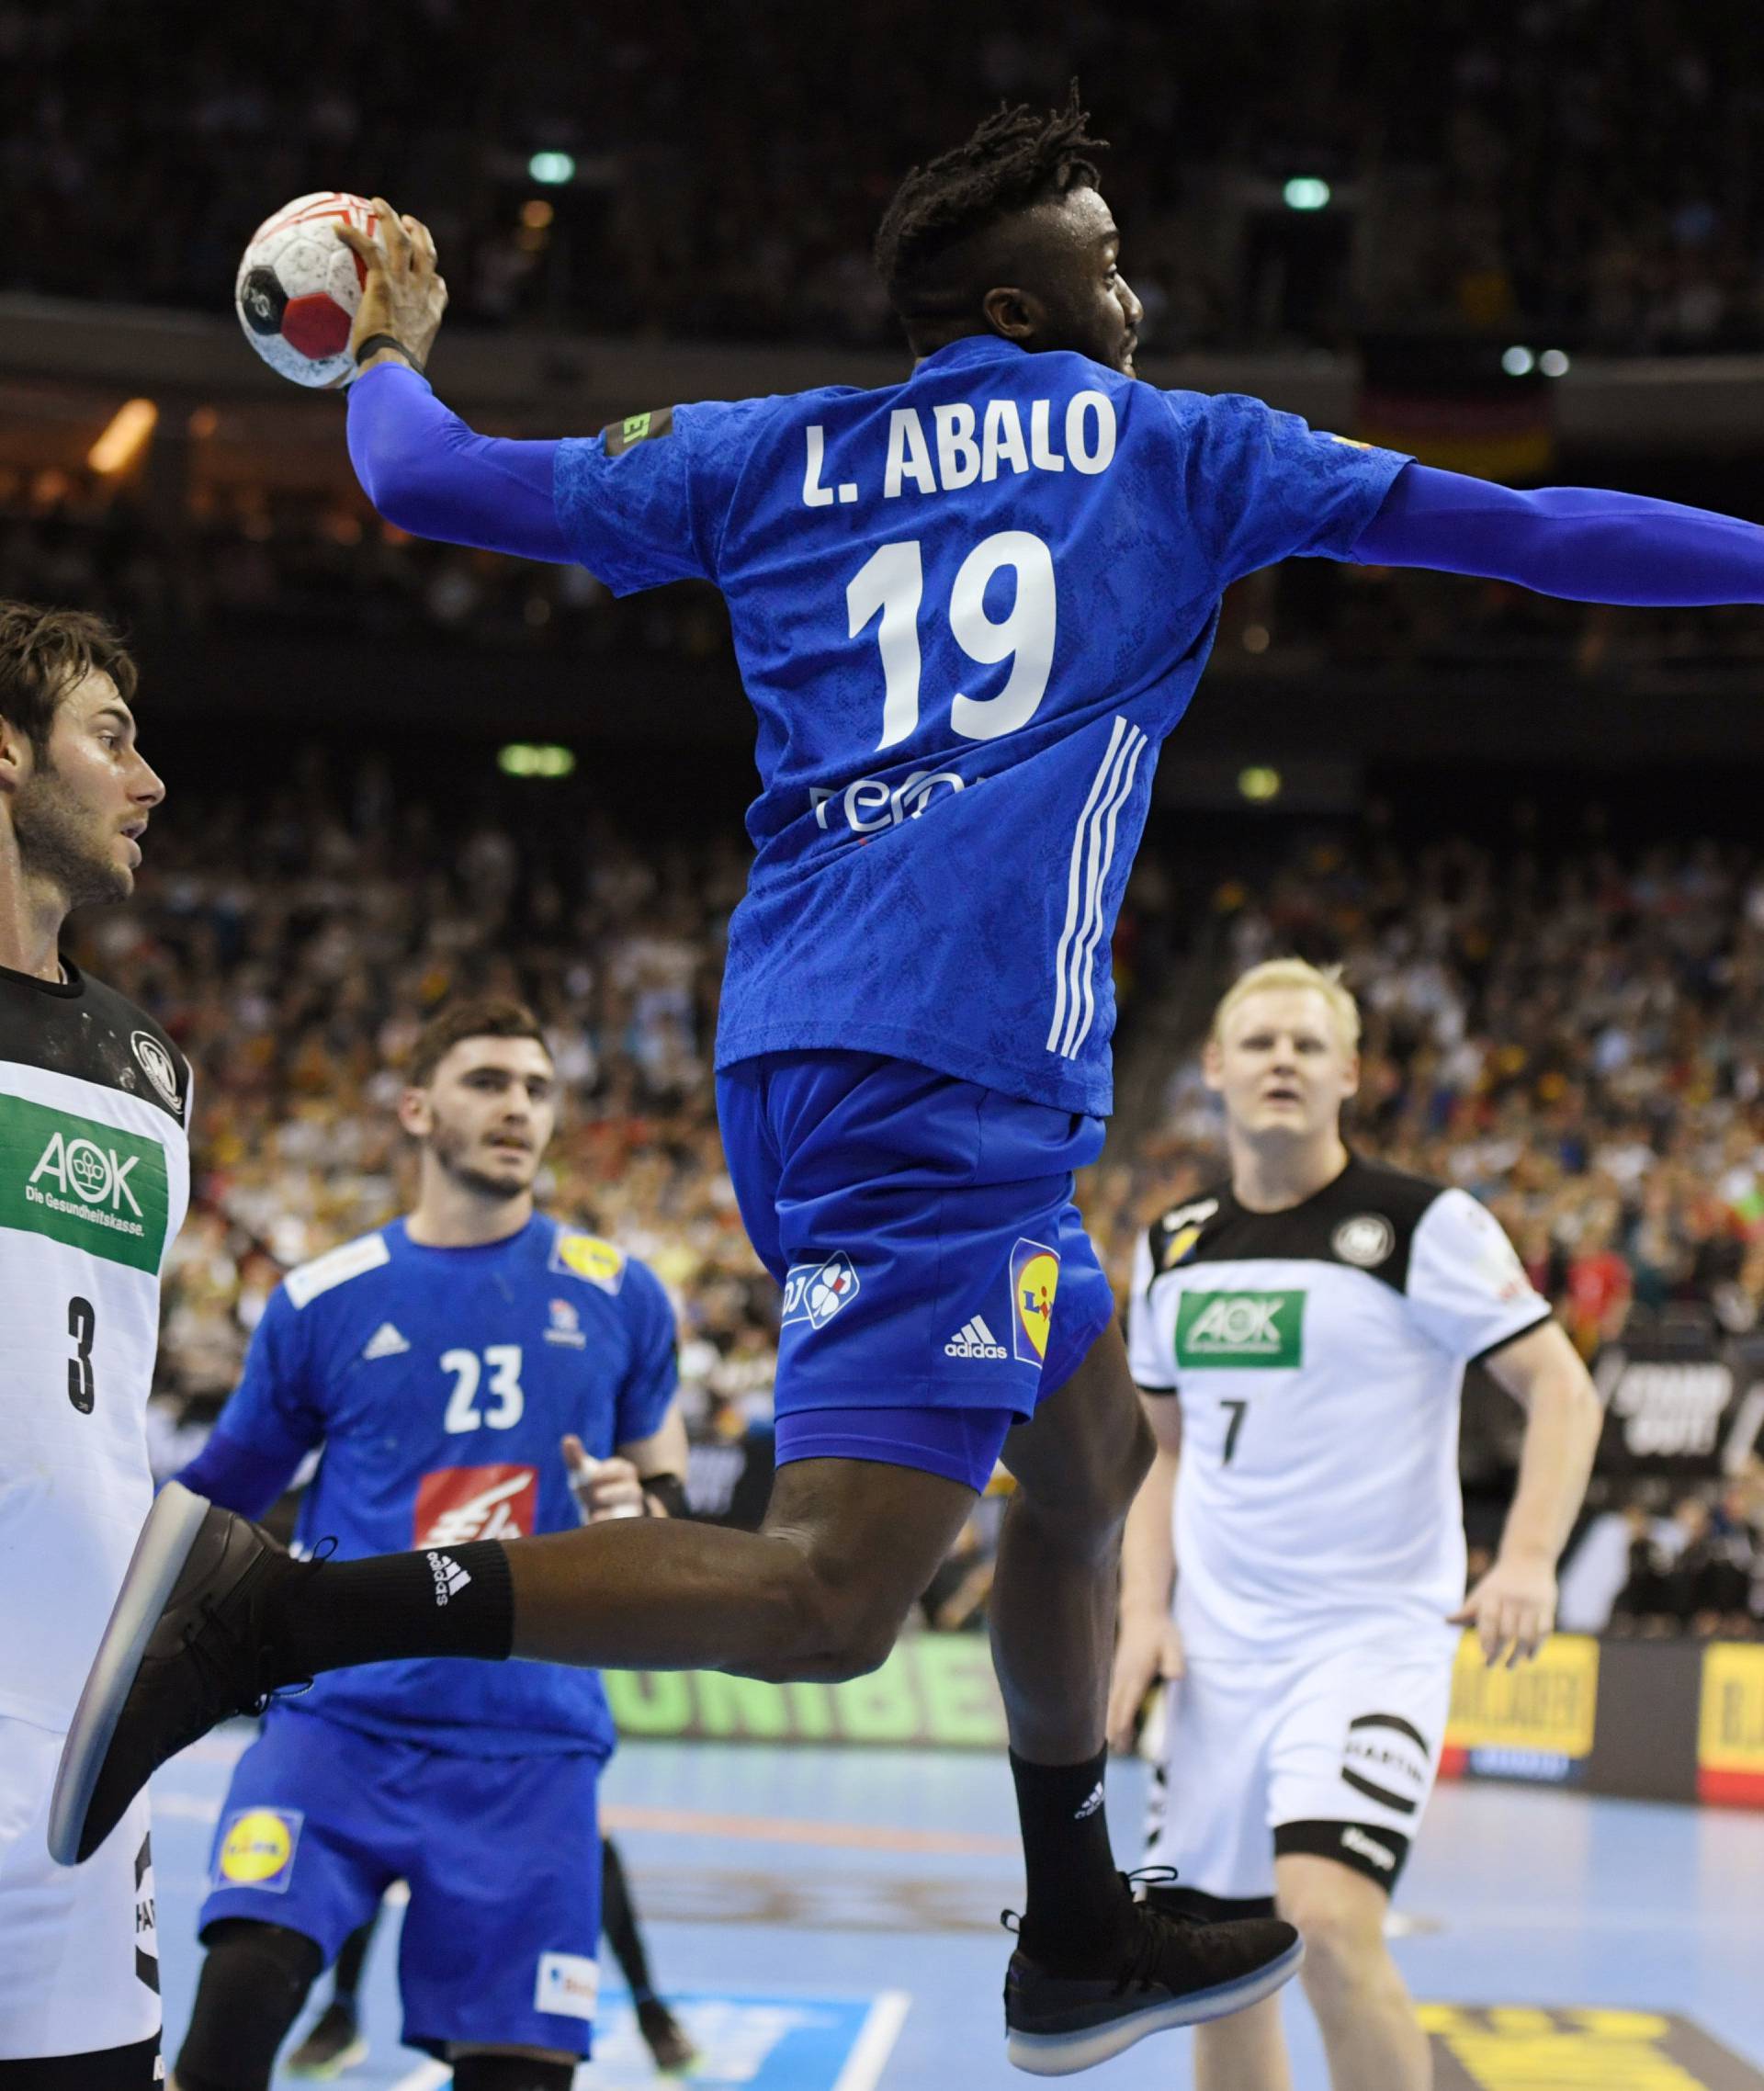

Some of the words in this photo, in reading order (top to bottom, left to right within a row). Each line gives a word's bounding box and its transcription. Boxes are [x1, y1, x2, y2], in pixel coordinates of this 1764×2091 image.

[802, 424, 859, 507] L.
[884, 390, 1117, 498] ABALO
[845, 530, 1057, 751] 19
[808, 771, 987, 832] rem
[28, 1131, 143, 1217] AOK
[25, 1184, 44, 1204] Die
[45, 1192, 145, 1237] Gesundheitskasse.
[944, 1341, 1008, 1360] adidas
[1185, 1297, 1284, 1342] AOK
[68, 1295, 96, 1415] 3
[440, 1344, 525, 1434] 23
[1219, 1399, 1248, 1467] 7
[426, 1551, 448, 1607] adidas
